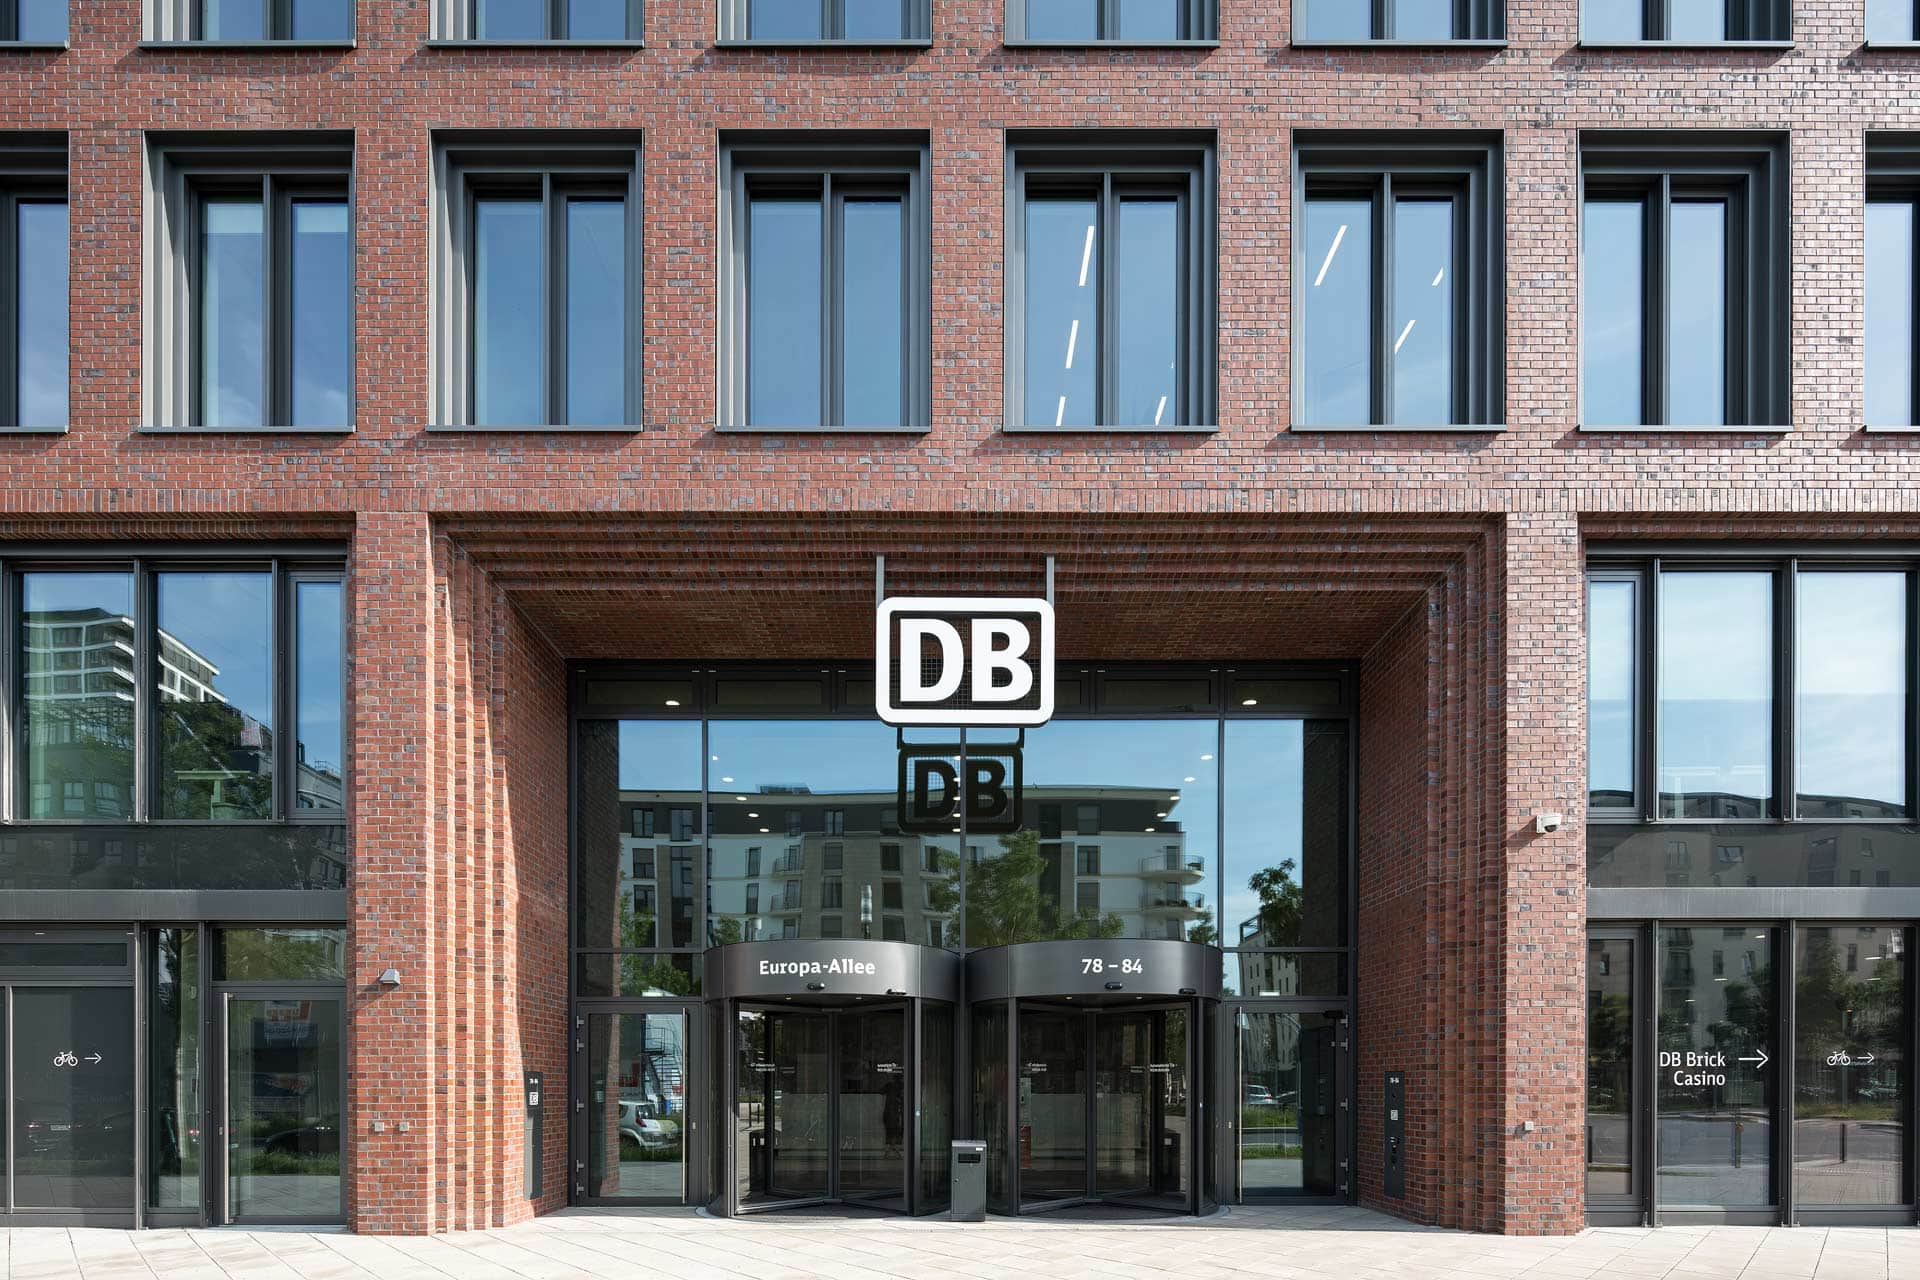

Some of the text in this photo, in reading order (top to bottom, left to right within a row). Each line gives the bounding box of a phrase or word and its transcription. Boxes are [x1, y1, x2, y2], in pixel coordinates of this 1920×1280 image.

[900, 618, 1033, 702] DB
[914, 759, 1008, 819] DB
[759, 957, 876, 978] Europa-Allee
[1081, 958, 1103, 974] 78
[1121, 958, 1144, 974] 84
[1659, 1051, 1726, 1067] DB Brick
[1673, 1070, 1726, 1086] Casino
